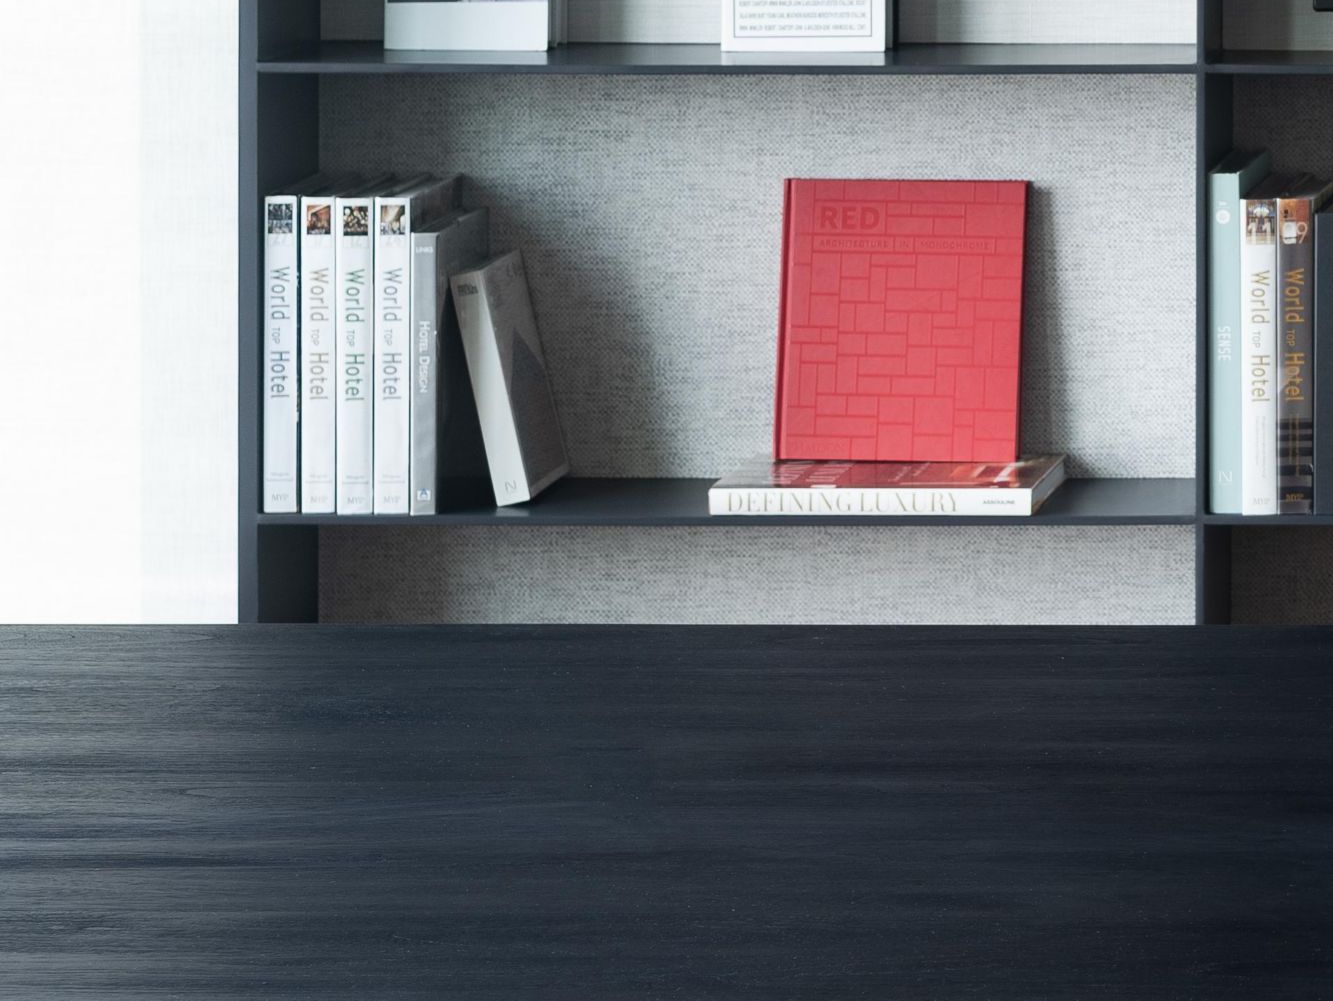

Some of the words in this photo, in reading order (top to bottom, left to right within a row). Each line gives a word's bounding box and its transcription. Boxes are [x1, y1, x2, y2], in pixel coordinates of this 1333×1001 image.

[820, 206, 881, 230] RED
[819, 239, 888, 248] ARCHITECTURE
[899, 240, 909, 248] IN
[920, 241, 989, 250] MONOCHROME
[270, 267, 291, 321] World
[309, 268, 329, 322] World
[345, 268, 366, 323] World
[382, 268, 402, 322] World
[1248, 269, 1271, 325] World
[1284, 268, 1306, 324] World
[271, 327, 281, 344] TOP
[310, 328, 320, 346] TOP
[346, 330, 356, 347] TOP
[383, 328, 393, 346] TOP
[1217, 325, 1231, 362] SENSE
[1250, 330, 1262, 349] TOP
[1286, 328, 1297, 348] TOP
[270, 351, 291, 399] Hotel
[309, 352, 329, 401] Hotel
[344, 353, 366, 402] Hotel
[382, 352, 402, 401] Hotel
[1250, 354, 1271, 403] Hotel
[1284, 352, 1306, 402] Hotel
[726, 490, 851, 513] DEFINING
[859, 490, 959, 513] LUXURY
